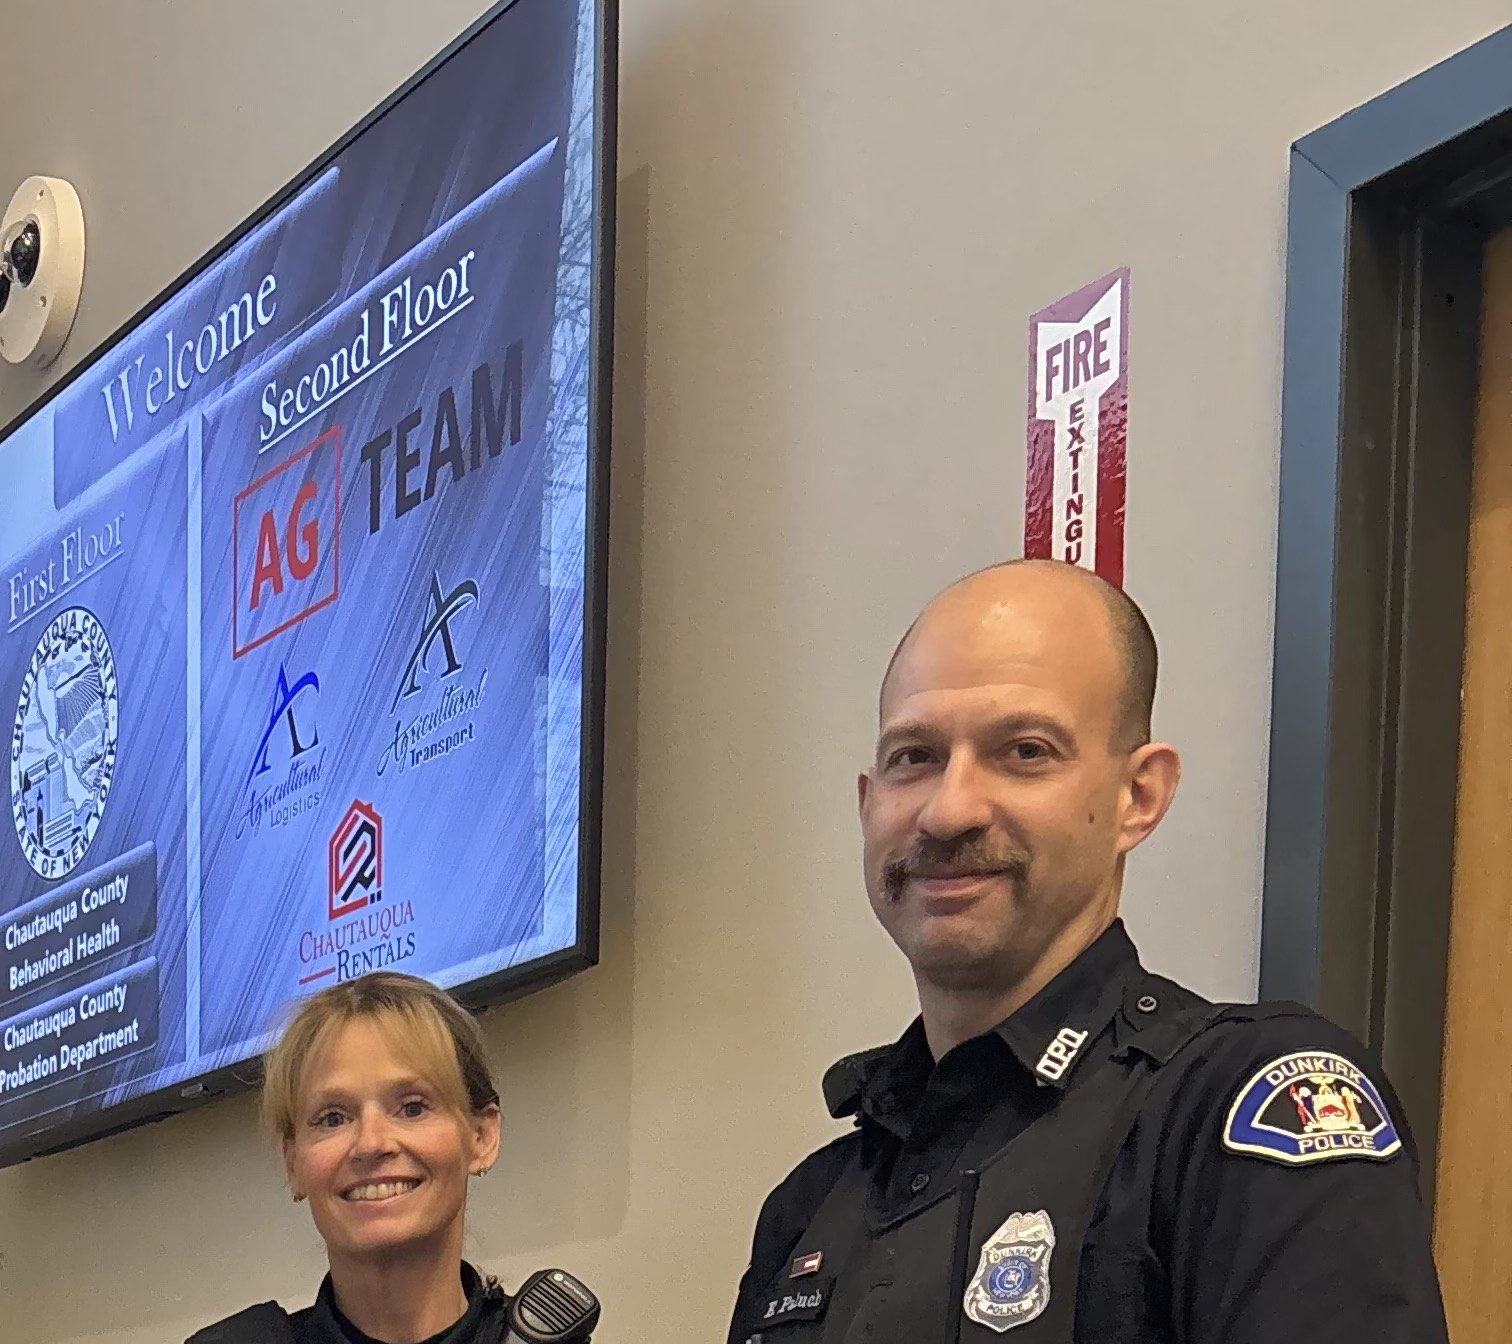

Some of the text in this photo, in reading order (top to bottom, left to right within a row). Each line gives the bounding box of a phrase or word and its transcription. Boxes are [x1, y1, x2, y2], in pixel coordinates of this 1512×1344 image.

[101, 273, 277, 443] Welcome
[259, 250, 475, 442] Second Floor
[1044, 315, 1112, 404] FIRE
[248, 339, 524, 612] AG TEAM
[8, 510, 125, 624] First Floor
[12, 610, 118, 763] CHAUTAUQUA COUNTY
[376, 667, 489, 779] Agricultural
[409, 721, 475, 768] Transport
[12, 739, 118, 876] STATE OF NEW YORK
[235, 746, 327, 841] Agricultural
[269, 790, 322, 829] Logistics
[4, 873, 130, 951] Chautauqua County
[298, 899, 415, 964] CHAUTAUQUA
[9, 917, 120, 991] Behavioral Health
[336, 931, 416, 983] RENTALS
[3, 982, 128, 1052] Chautauqua County
[60, 1017, 139, 1071] Department
[1264, 1057, 1363, 1087] DUNKIRK
[1297, 1134, 1377, 1154] POLICE
